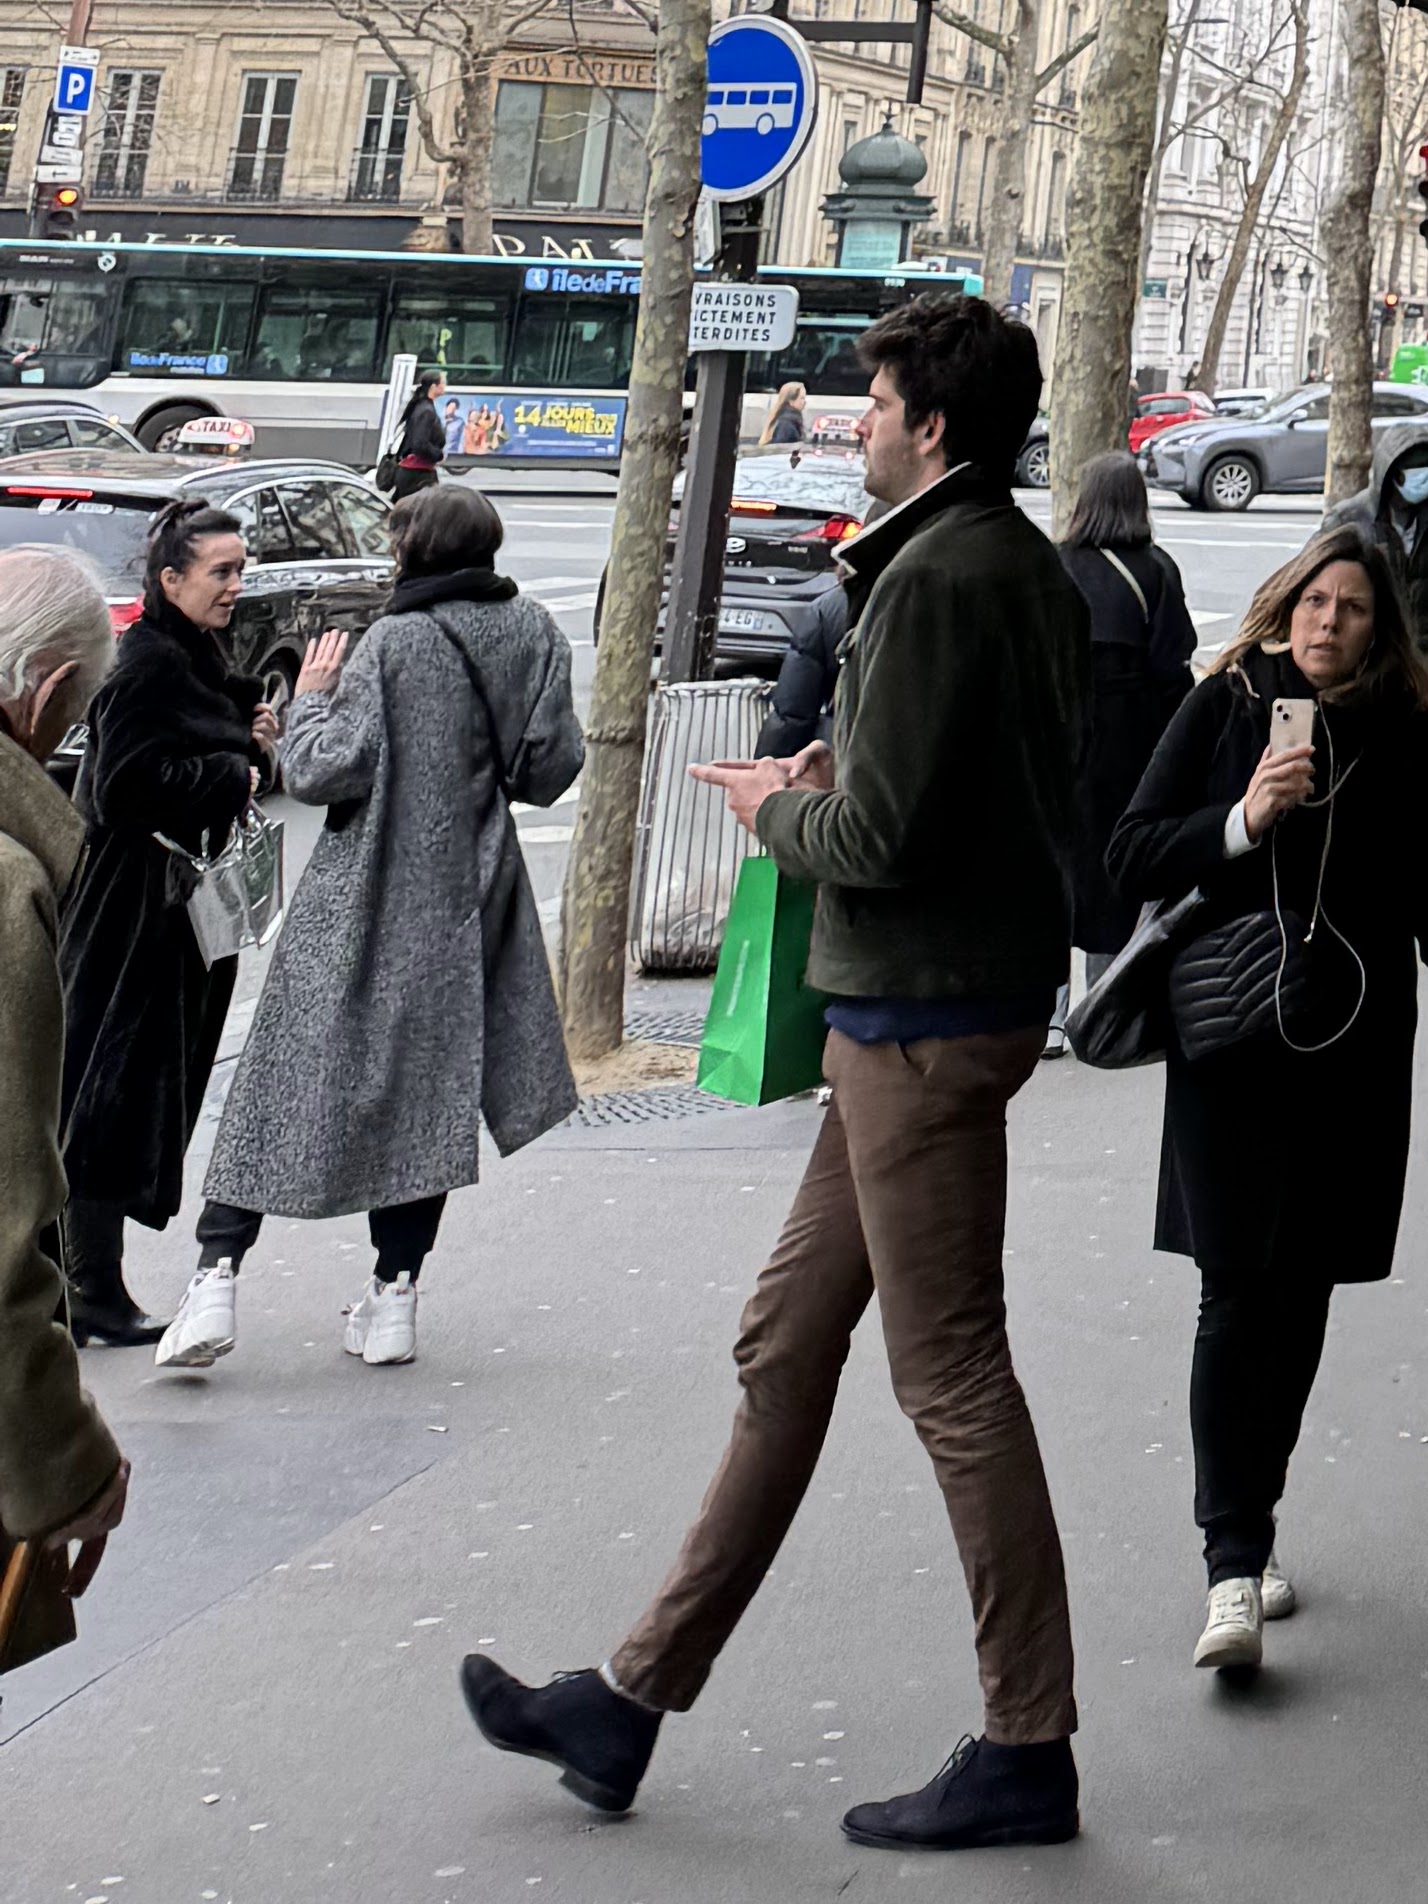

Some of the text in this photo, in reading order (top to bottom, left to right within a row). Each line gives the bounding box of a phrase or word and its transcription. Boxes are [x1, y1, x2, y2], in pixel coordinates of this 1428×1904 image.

[504, 57, 552, 77] AUX
[66, 73, 86, 104] P
[514, 404, 541, 426] 14
[203, 421, 231, 433] TAXI
[565, 417, 616, 435] MIEUX
